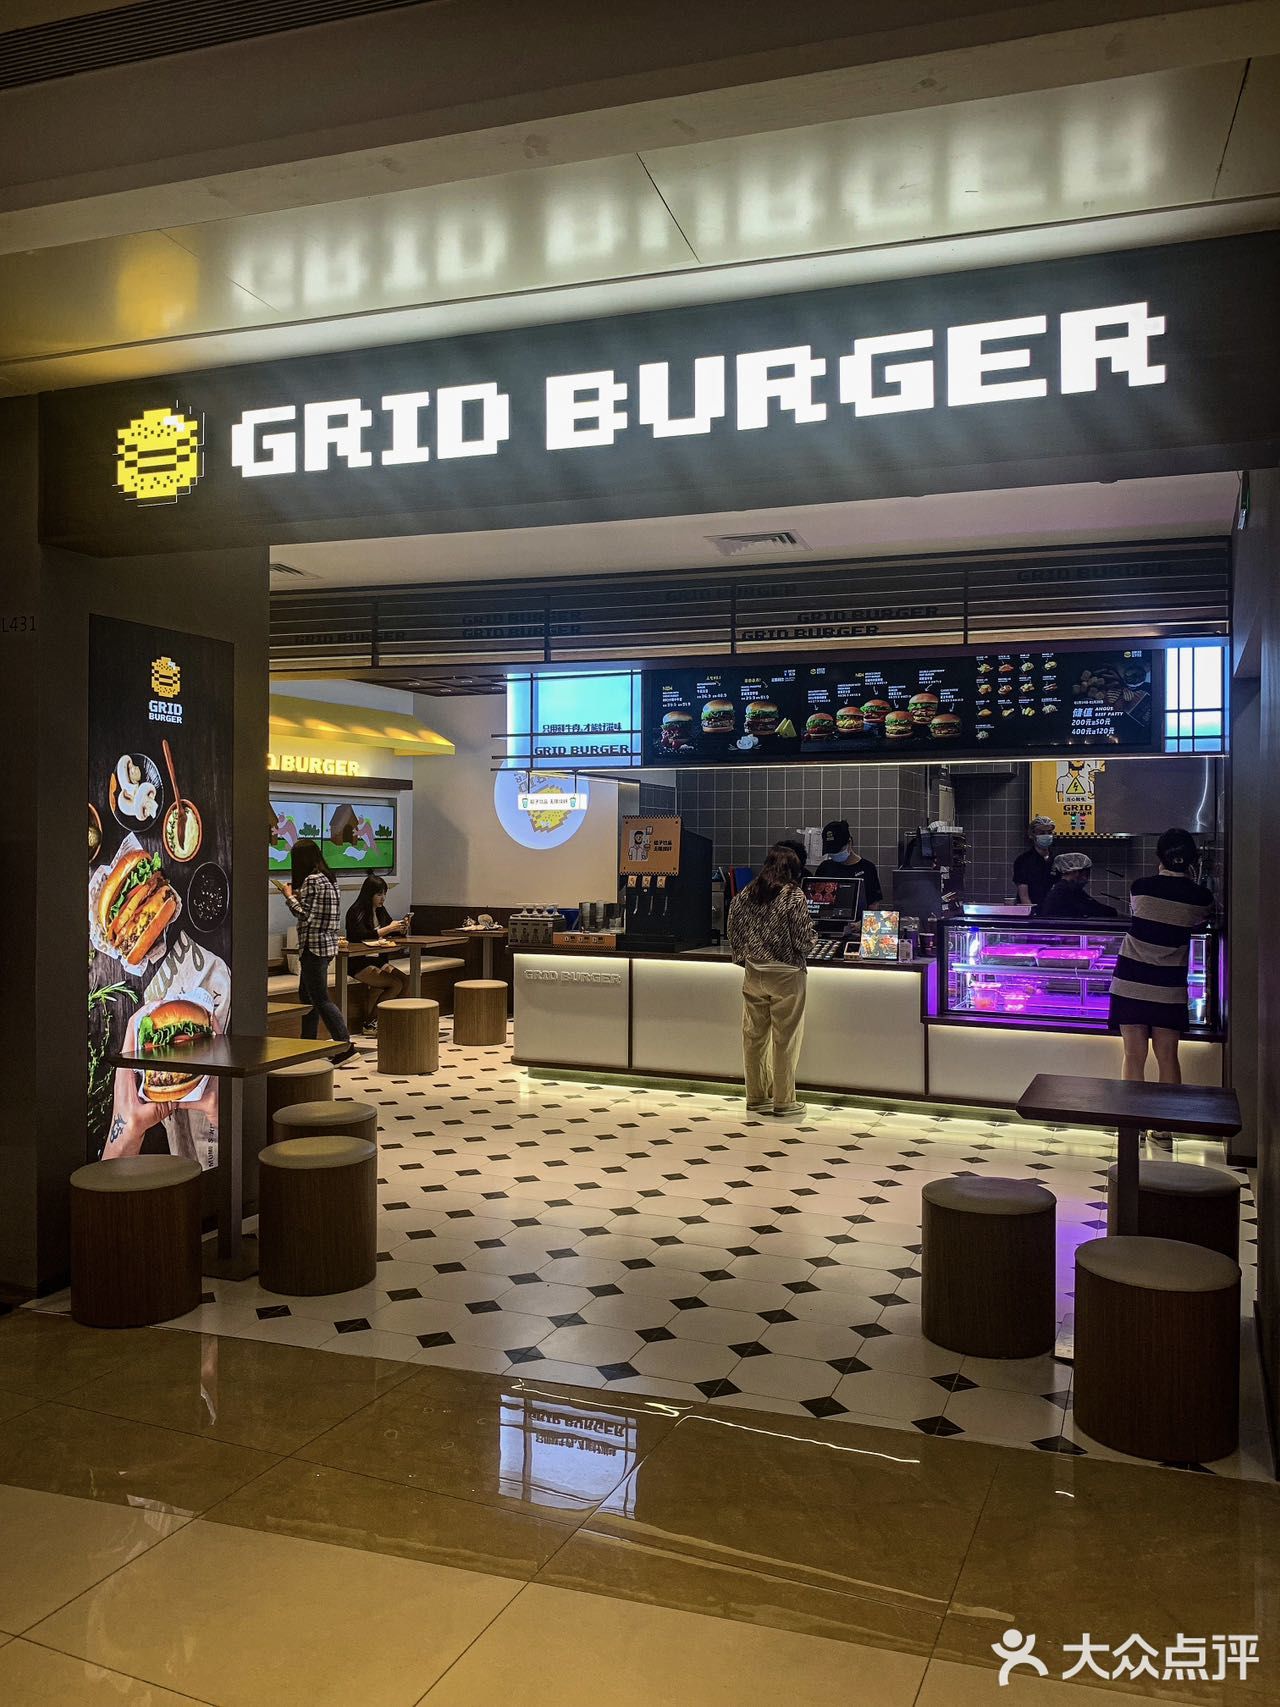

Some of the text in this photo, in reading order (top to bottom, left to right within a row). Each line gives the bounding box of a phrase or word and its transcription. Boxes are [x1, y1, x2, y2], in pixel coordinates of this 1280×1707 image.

[231, 301, 1167, 478] GRID BURGER
[148, 700, 182, 715] GRID
[148, 712, 182, 724] BURGER
[534, 744, 629, 756] GRID BURGER
[281, 754, 360, 776] BURGER
[561, 970, 622, 984] BURGER
